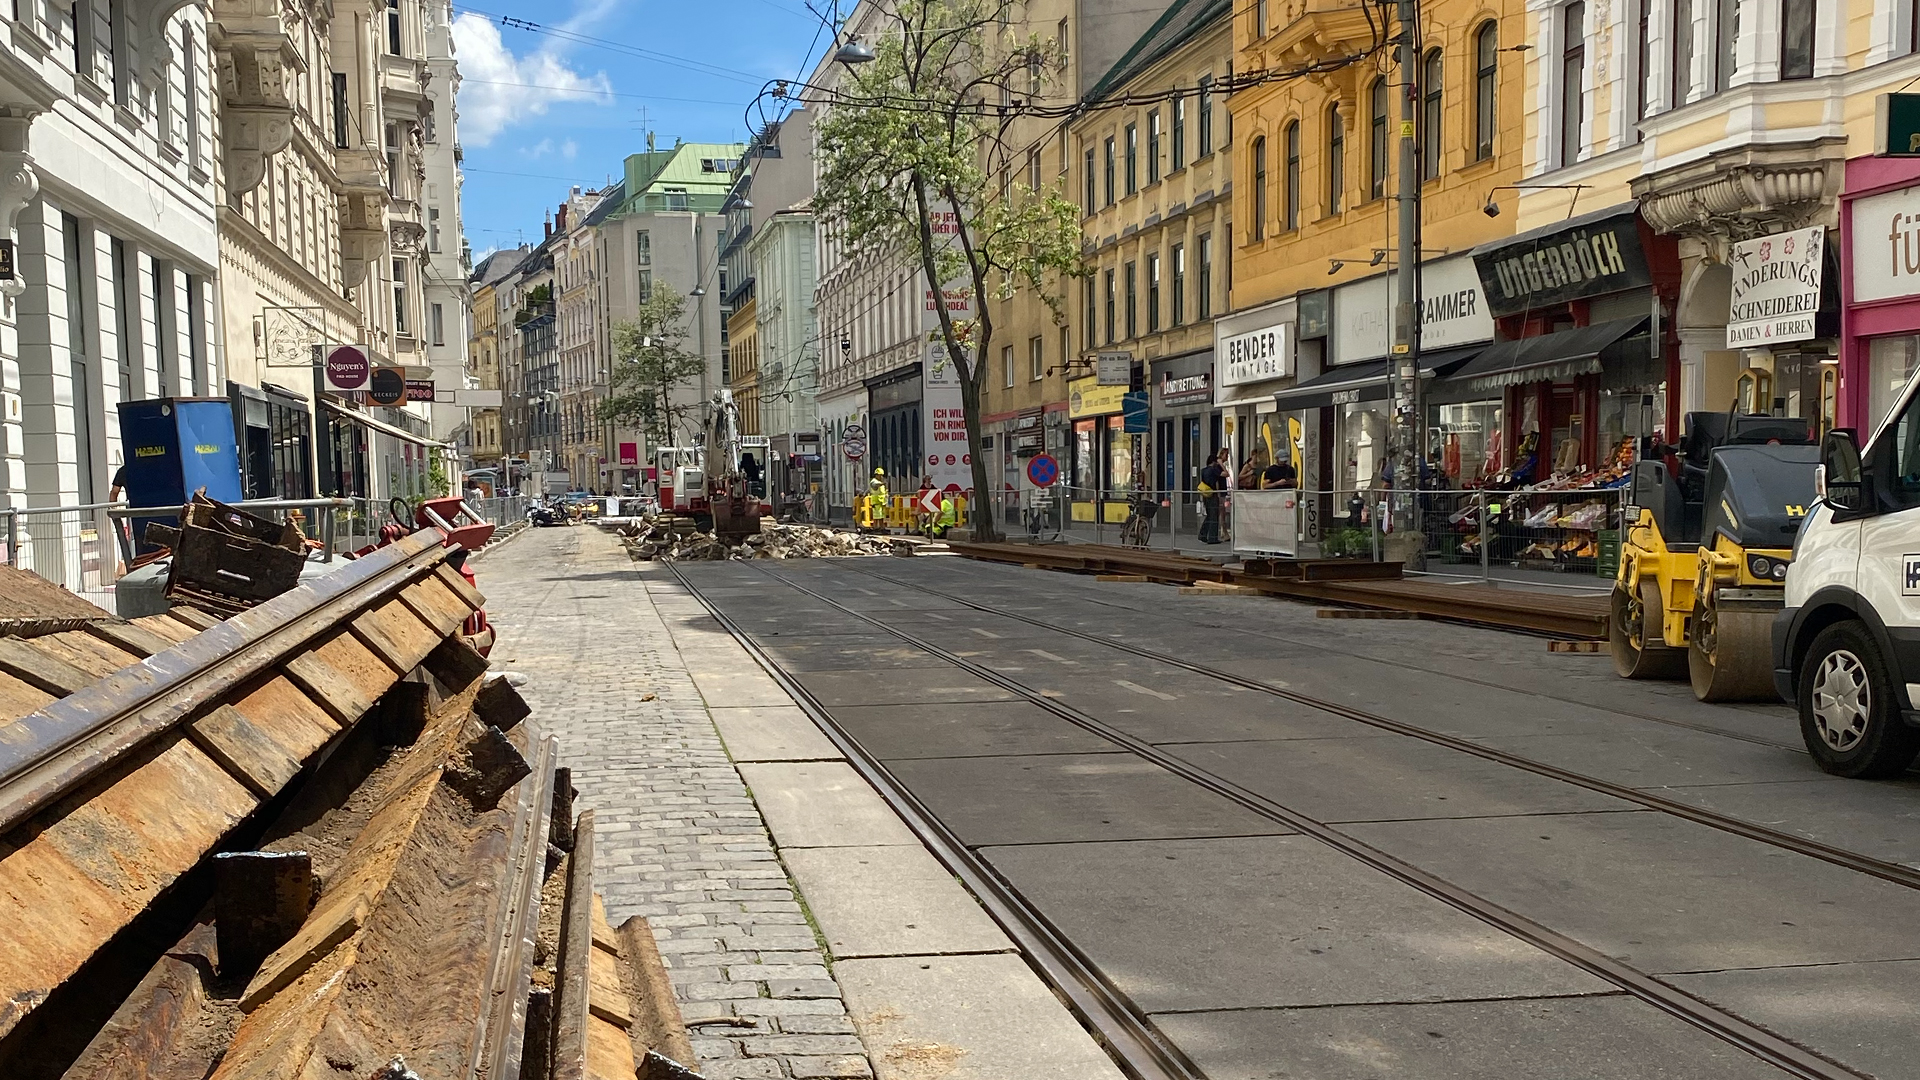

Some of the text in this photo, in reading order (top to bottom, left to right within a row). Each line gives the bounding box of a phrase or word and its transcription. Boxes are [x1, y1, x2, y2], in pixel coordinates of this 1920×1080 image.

[1494, 229, 1626, 298] UNGERBÖCK
[1733, 260, 1819, 303] ÄNDERUNGS-
[926, 301, 969, 310] LUHDEAL
[1731, 292, 1818, 322] SCHNEIDEREI
[1352, 308, 1388, 336] KATHA
[1730, 319, 1814, 342] DAMEN & HERREN
[1230, 332, 1275, 364] BENDER
[330, 362, 364, 372] Nguyen's
[1231, 360, 1275, 379] VINTAGE
[933, 409, 964, 418] ICH WIL
[933, 421, 946, 430] EIN
[933, 432, 950, 441] VON
